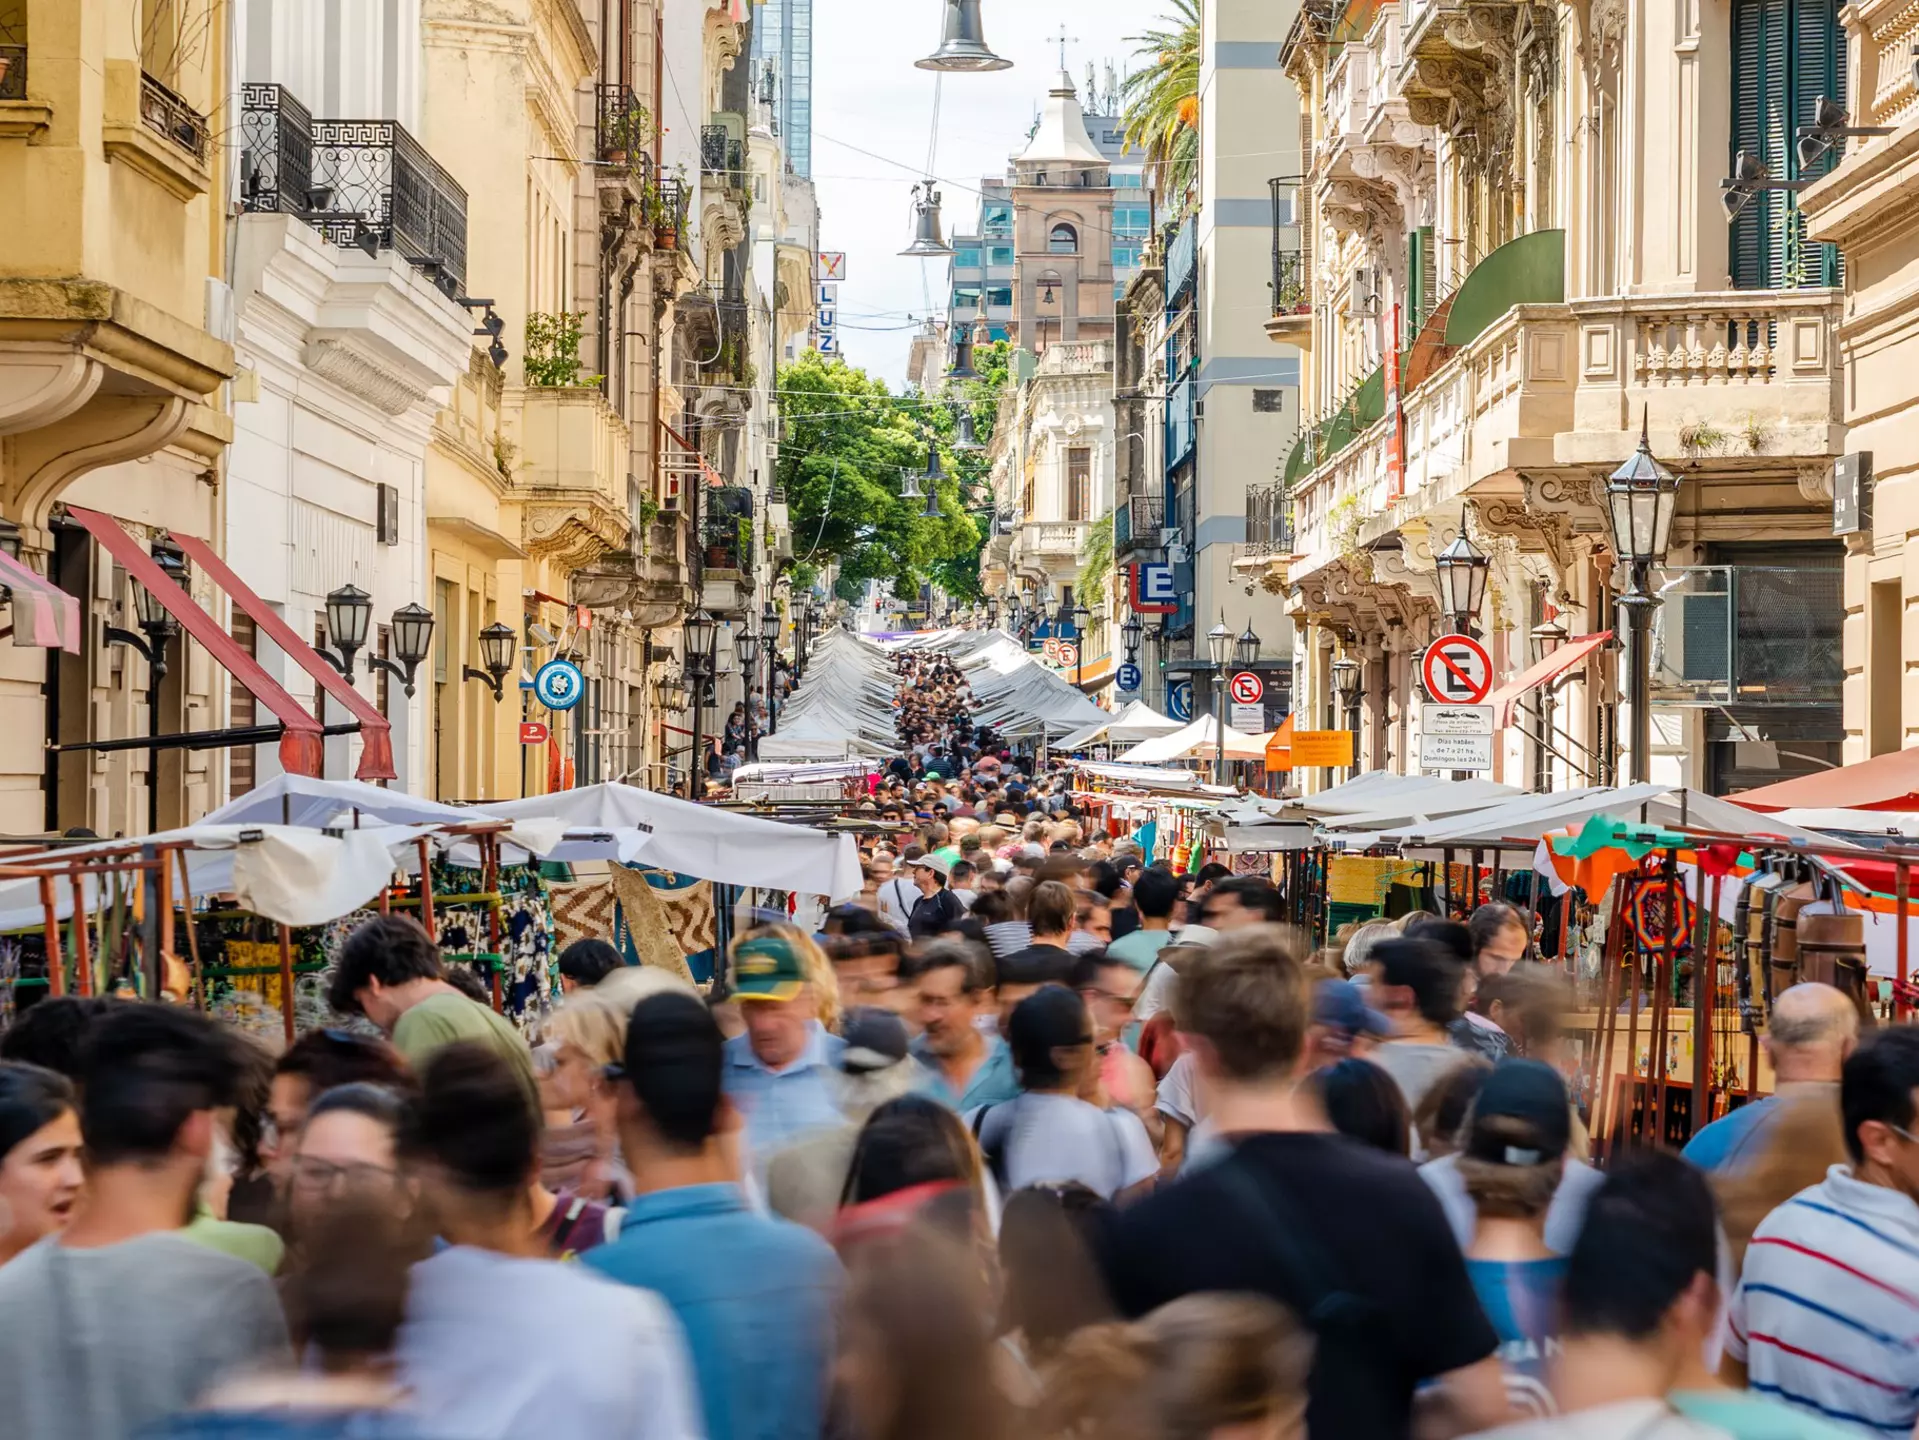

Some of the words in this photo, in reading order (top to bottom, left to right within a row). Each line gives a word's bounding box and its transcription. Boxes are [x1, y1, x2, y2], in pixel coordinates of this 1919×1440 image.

[820, 286, 833, 351] LUZ
[1147, 567, 1177, 598] E
[1119, 667, 1132, 684] E
[1445, 651, 1473, 693] E
[1240, 679, 1252, 698] E
[1423, 755, 1456, 763] Domingos
